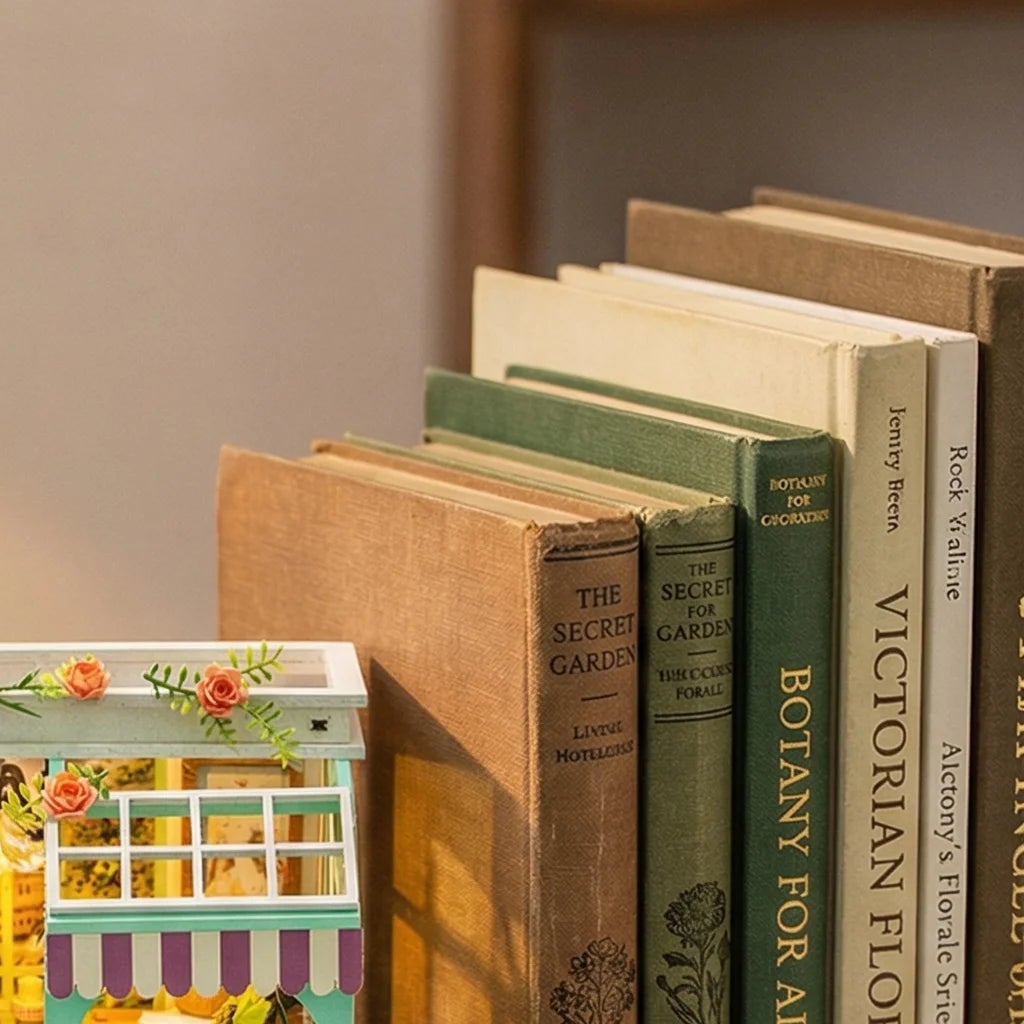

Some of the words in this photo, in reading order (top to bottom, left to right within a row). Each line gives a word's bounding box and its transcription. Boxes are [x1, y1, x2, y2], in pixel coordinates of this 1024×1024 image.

[948, 445, 969, 503] Rock
[687, 561, 717, 577] THE
[576, 584, 622, 609] THE
[661, 577, 732, 600] SECRET
[687, 603, 717, 619] FOR
[552, 612, 636, 644] SECRET
[656, 617, 733, 642] GARDEN
[549, 644, 636, 676] GARDEN
[869, 583, 909, 891] VICTORIAN
[777, 664, 812, 857] BOTANY
[777, 873, 809, 967] FOR
[936, 873, 960, 965] Florale
